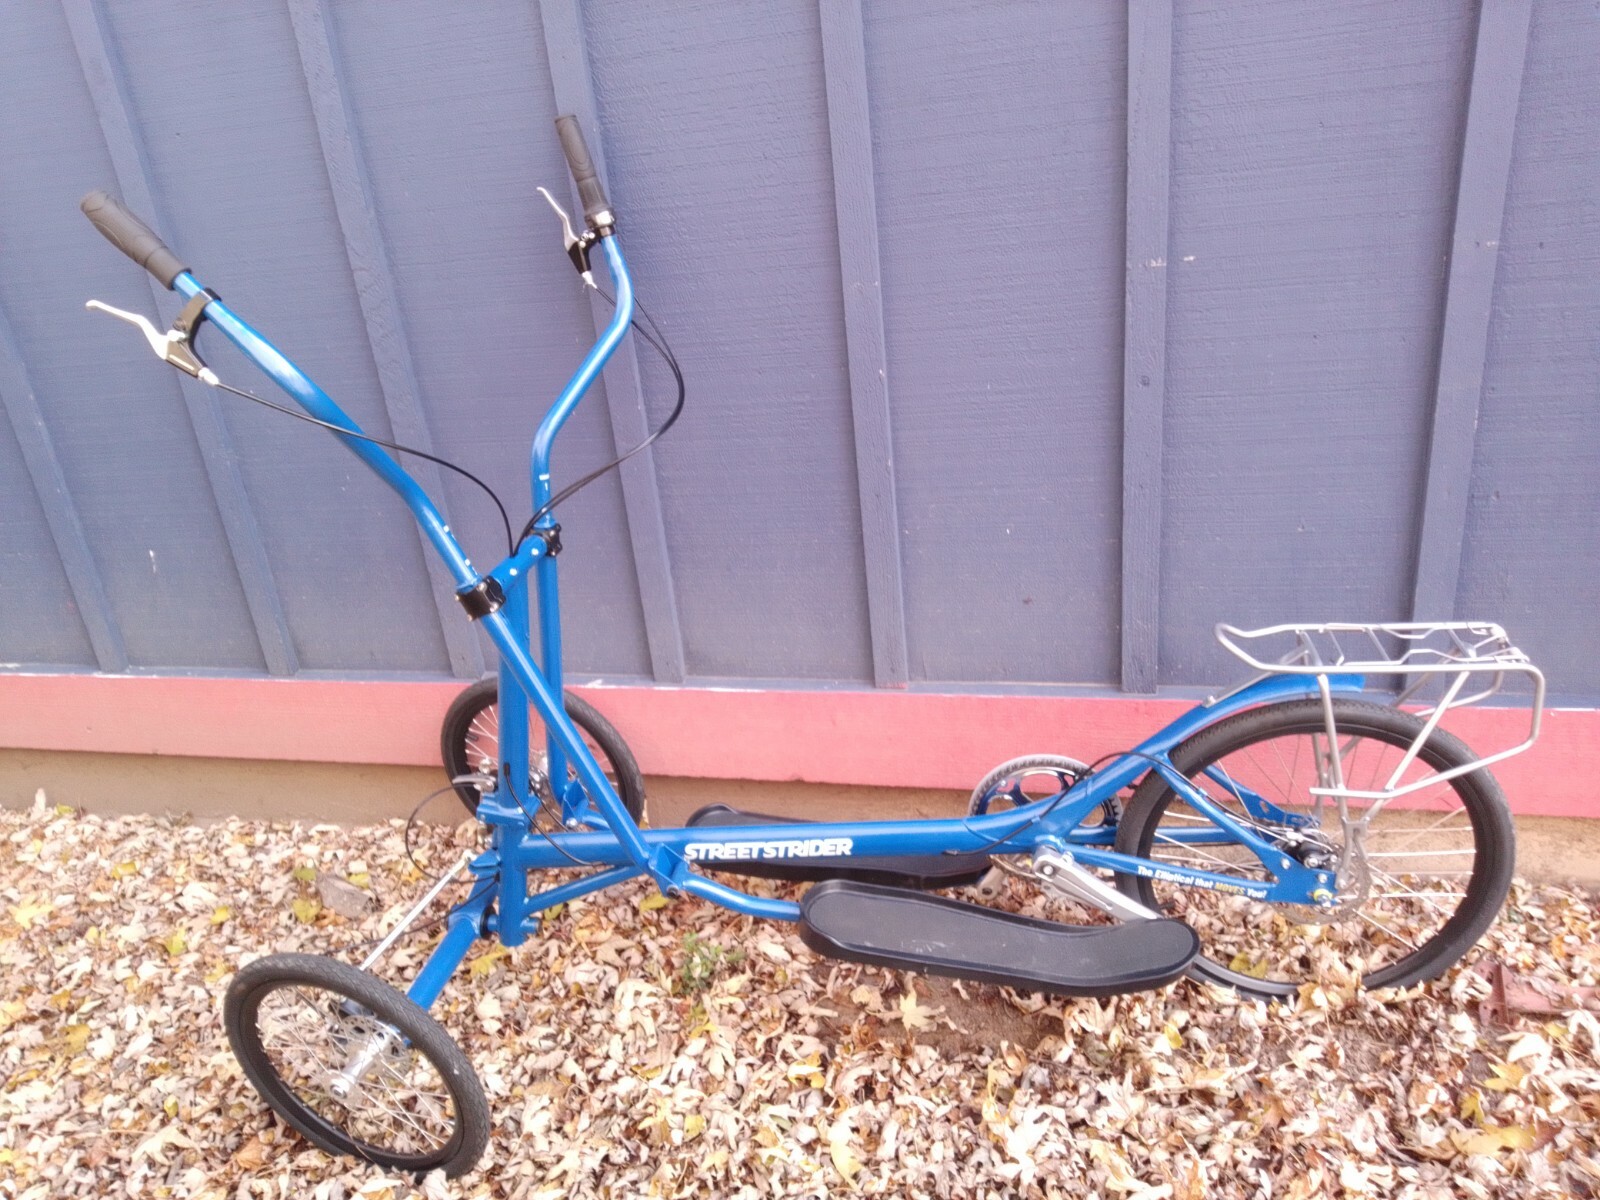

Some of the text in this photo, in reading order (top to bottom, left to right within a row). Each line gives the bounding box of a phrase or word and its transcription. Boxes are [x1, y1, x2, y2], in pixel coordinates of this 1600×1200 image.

[684, 837, 854, 861] STREETSTRIDER
[1137, 865, 1268, 899] The Elliptical that MOVES You!
